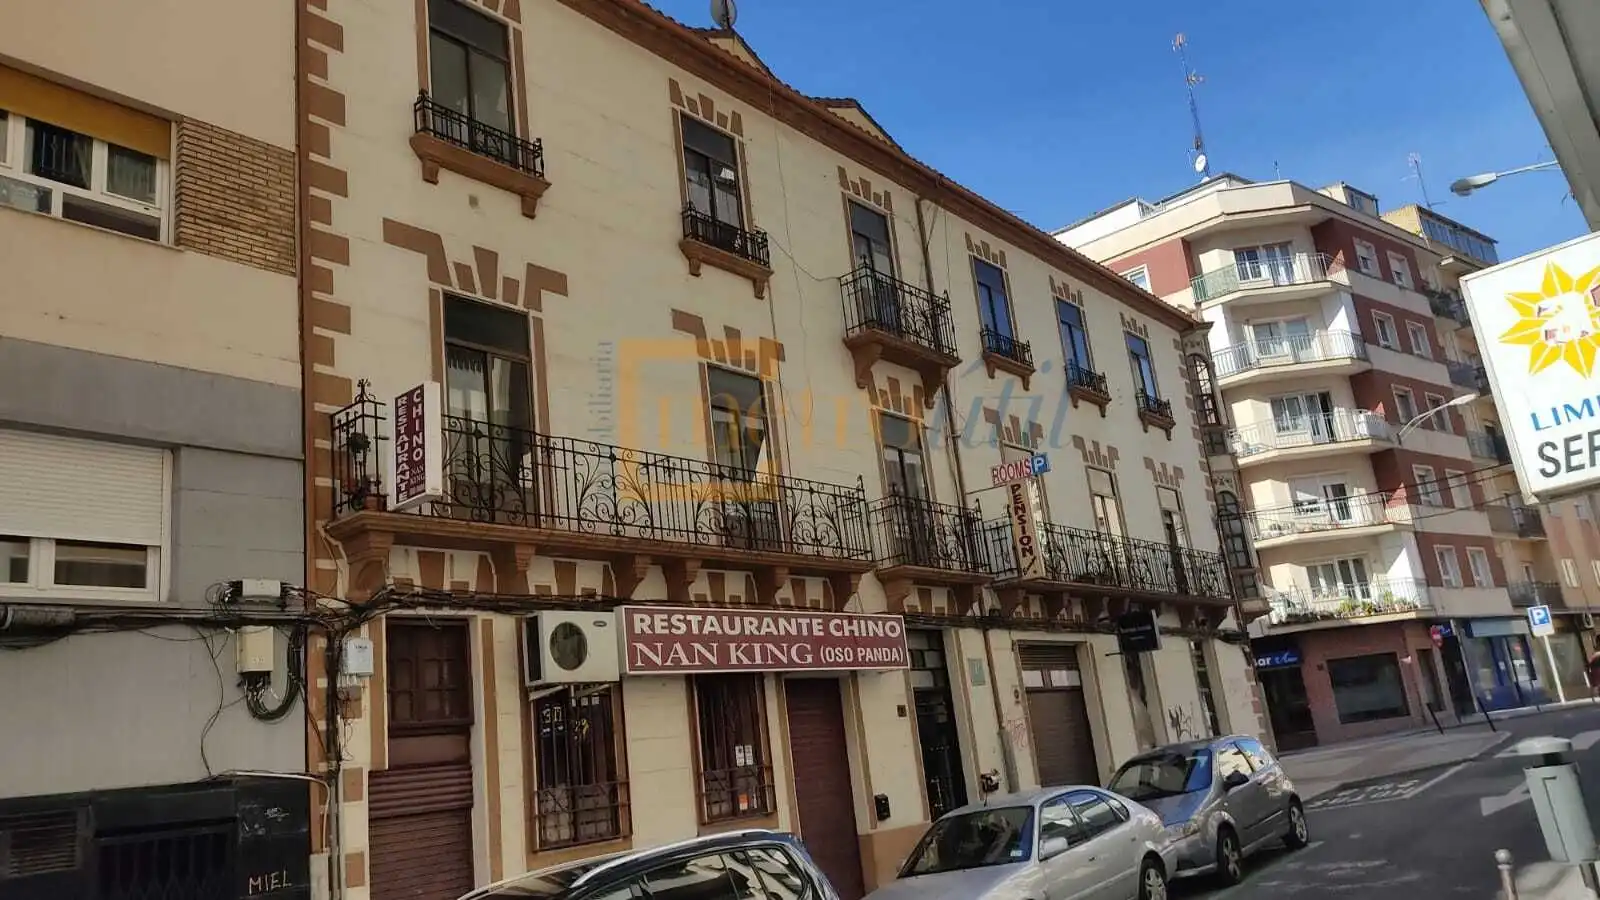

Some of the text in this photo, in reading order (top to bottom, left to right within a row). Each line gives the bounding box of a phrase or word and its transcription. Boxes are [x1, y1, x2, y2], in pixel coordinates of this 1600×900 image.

[412, 389, 423, 462] CHINO
[1530, 394, 1600, 431] LIM
[397, 395, 410, 500] RESTAURANTE
[992, 458, 1032, 485] ROOMS
[633, 613, 825, 637] RESTAURANTE
[829, 617, 901, 638] CHINO
[1531, 607, 1546, 625] P
[633, 641, 904, 667] NAN KING (OSO PANDA)
[249, 869, 293, 896] MIEL
